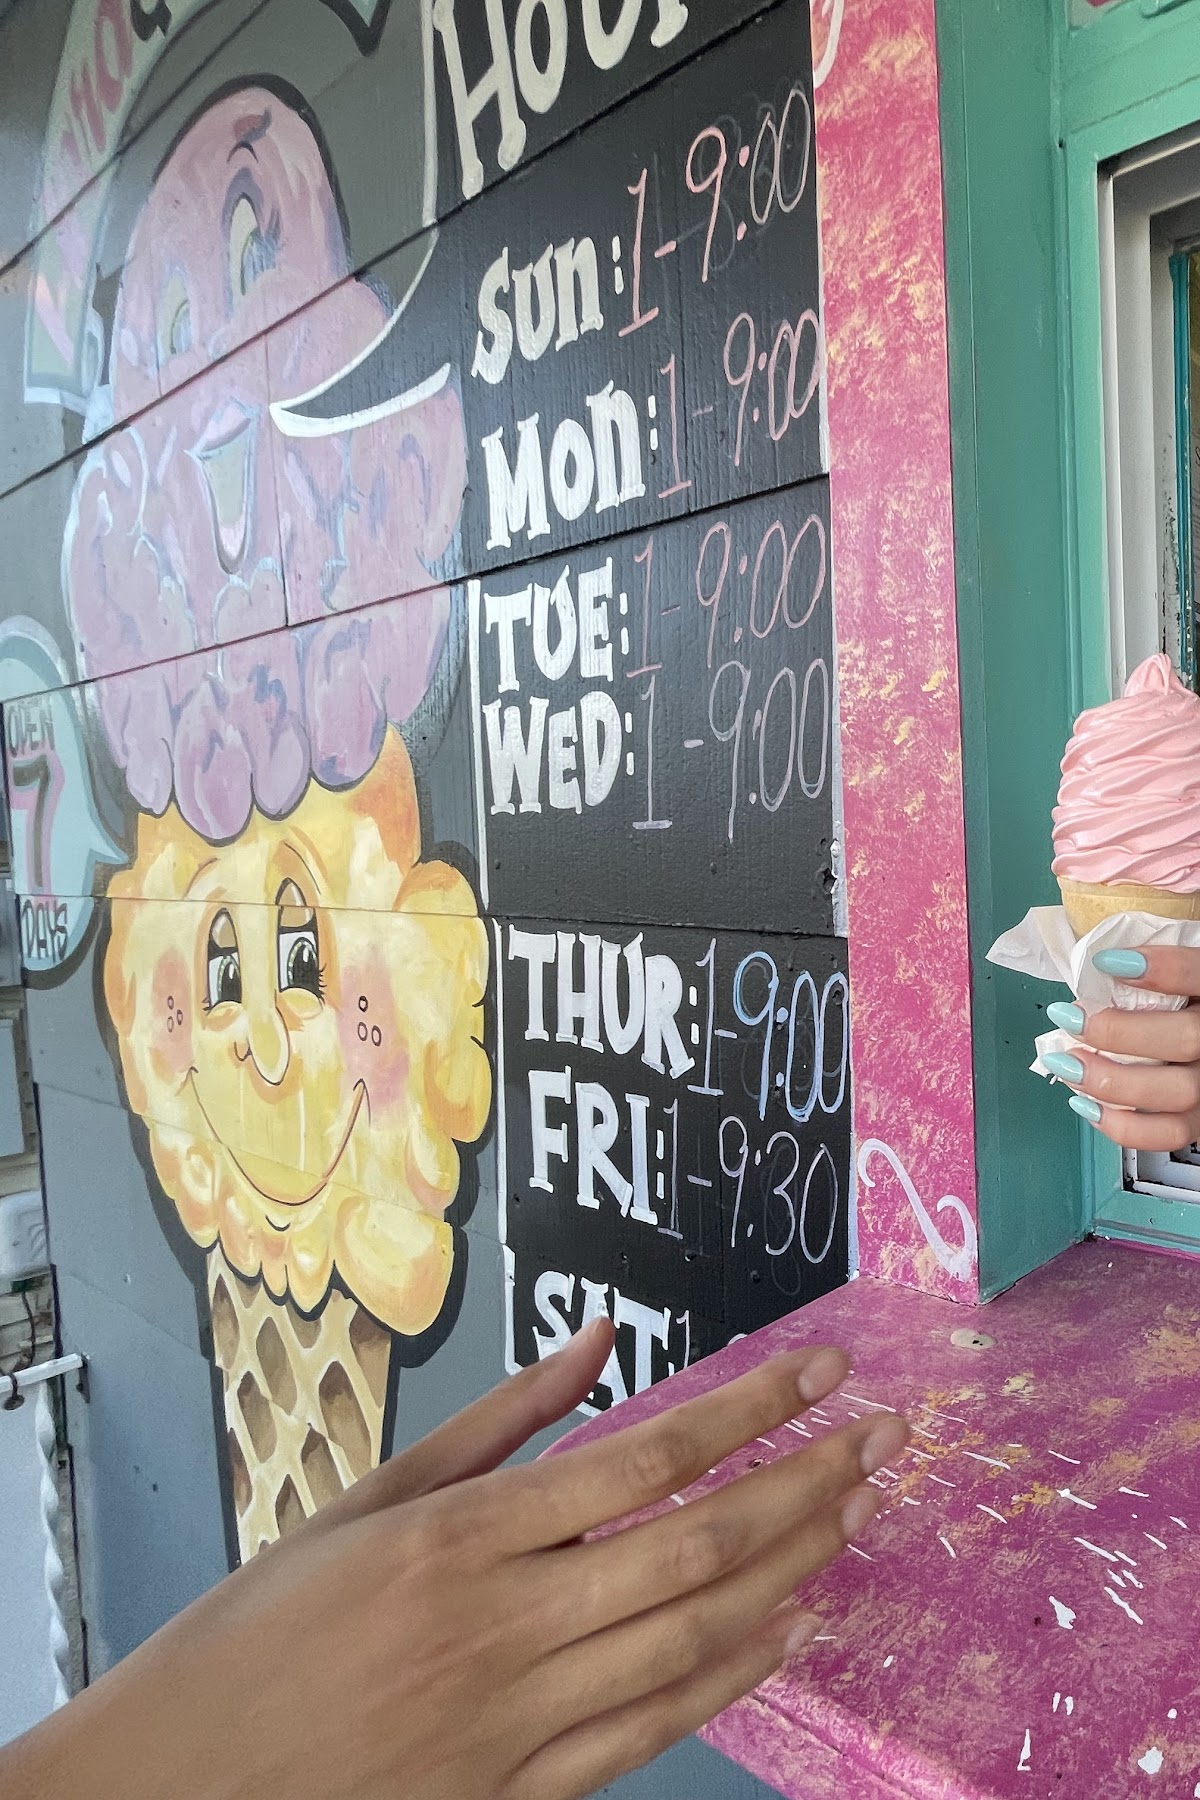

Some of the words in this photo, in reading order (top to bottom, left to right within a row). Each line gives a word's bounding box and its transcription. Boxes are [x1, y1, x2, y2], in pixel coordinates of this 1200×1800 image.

[8, 704, 56, 758] OPEN
[11, 750, 59, 893] 7
[20, 898, 69, 964] DAYS
[508, 923, 700, 1079] THUR:
